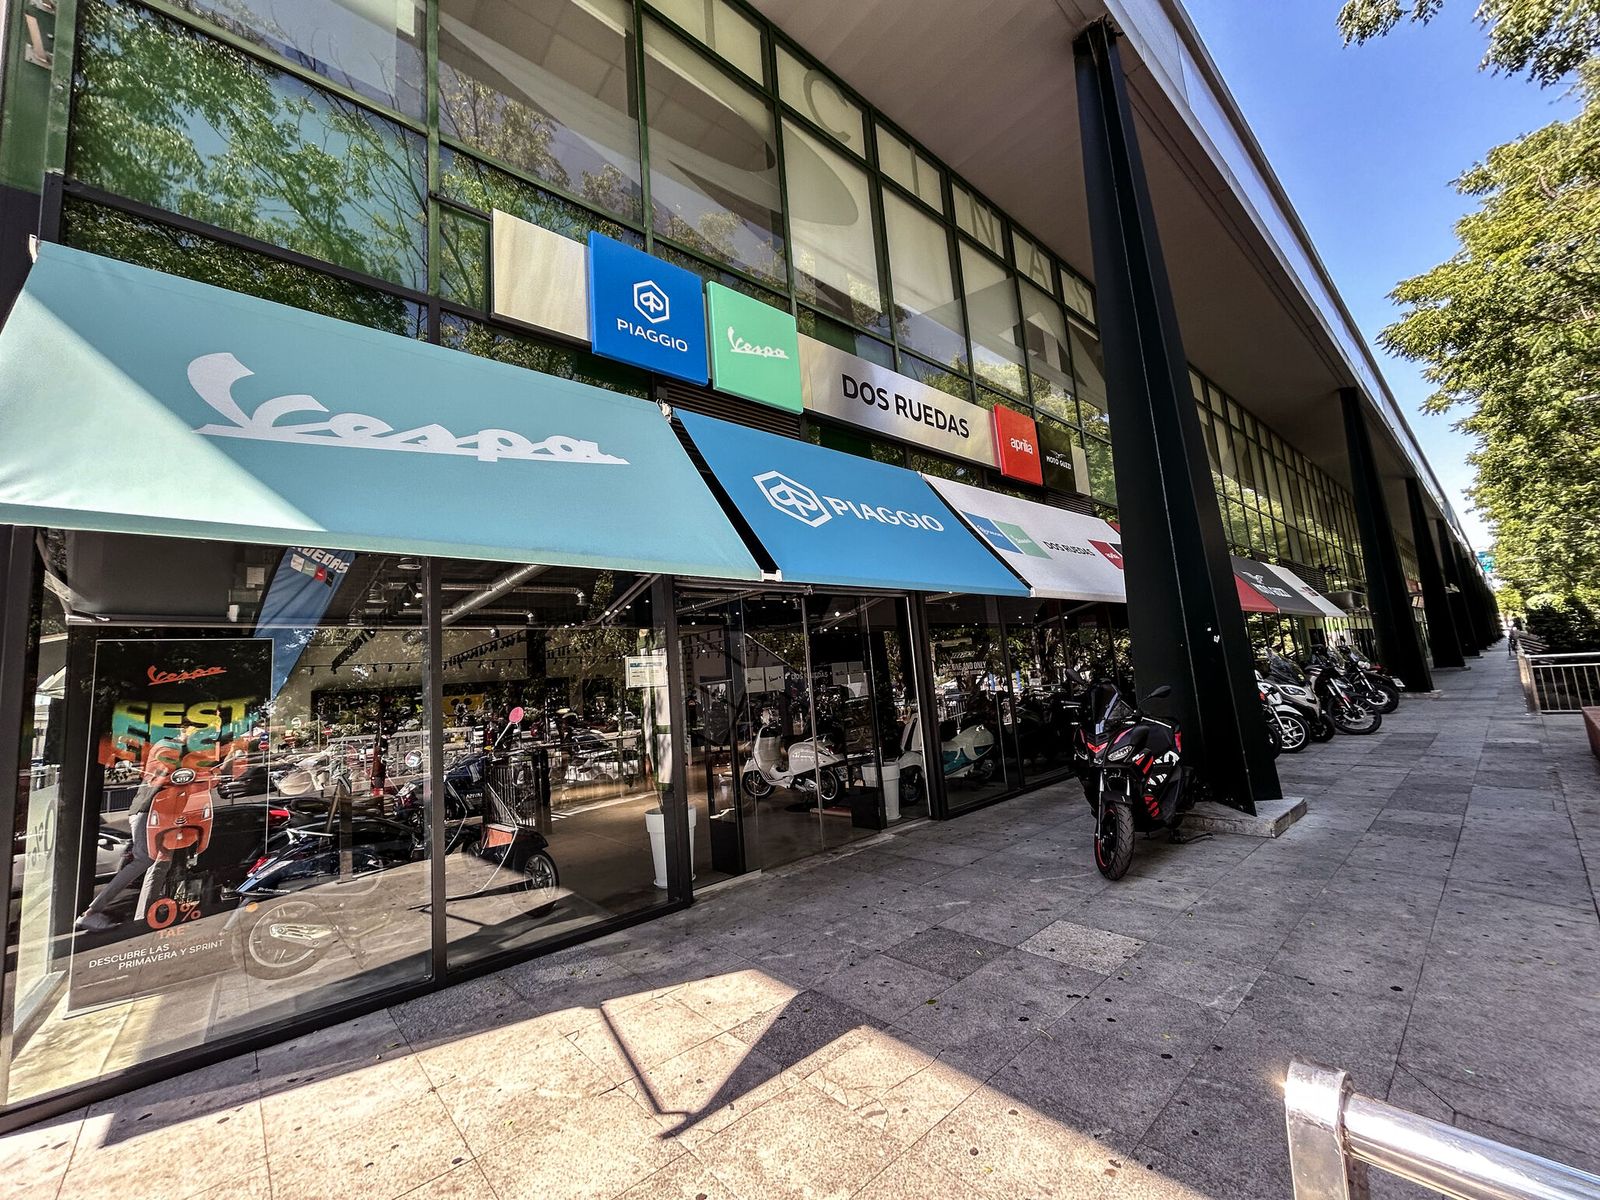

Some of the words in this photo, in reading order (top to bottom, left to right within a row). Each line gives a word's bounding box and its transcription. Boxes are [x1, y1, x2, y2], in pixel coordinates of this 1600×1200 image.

[616, 318, 688, 353] PIAGGIO
[727, 326, 789, 360] Vespa
[187, 352, 631, 463] Vespa
[841, 373, 890, 411] DOS
[894, 393, 970, 439] RUEDAS
[1010, 437, 1033, 456] aprilia
[1046, 456, 1059, 465] MOTO
[822, 495, 945, 532] PIAGGIO
[1042, 540, 1065, 551] DOS
[147, 665, 228, 686] Vespa
[146, 897, 202, 929] 0%
[89, 949, 147, 969] DESCUBRE
[149, 943, 170, 955] LAS
[118, 951, 178, 971] PRIMAVERA
[180, 947, 188, 956] Y
[189, 939, 225, 954] SPRINT
